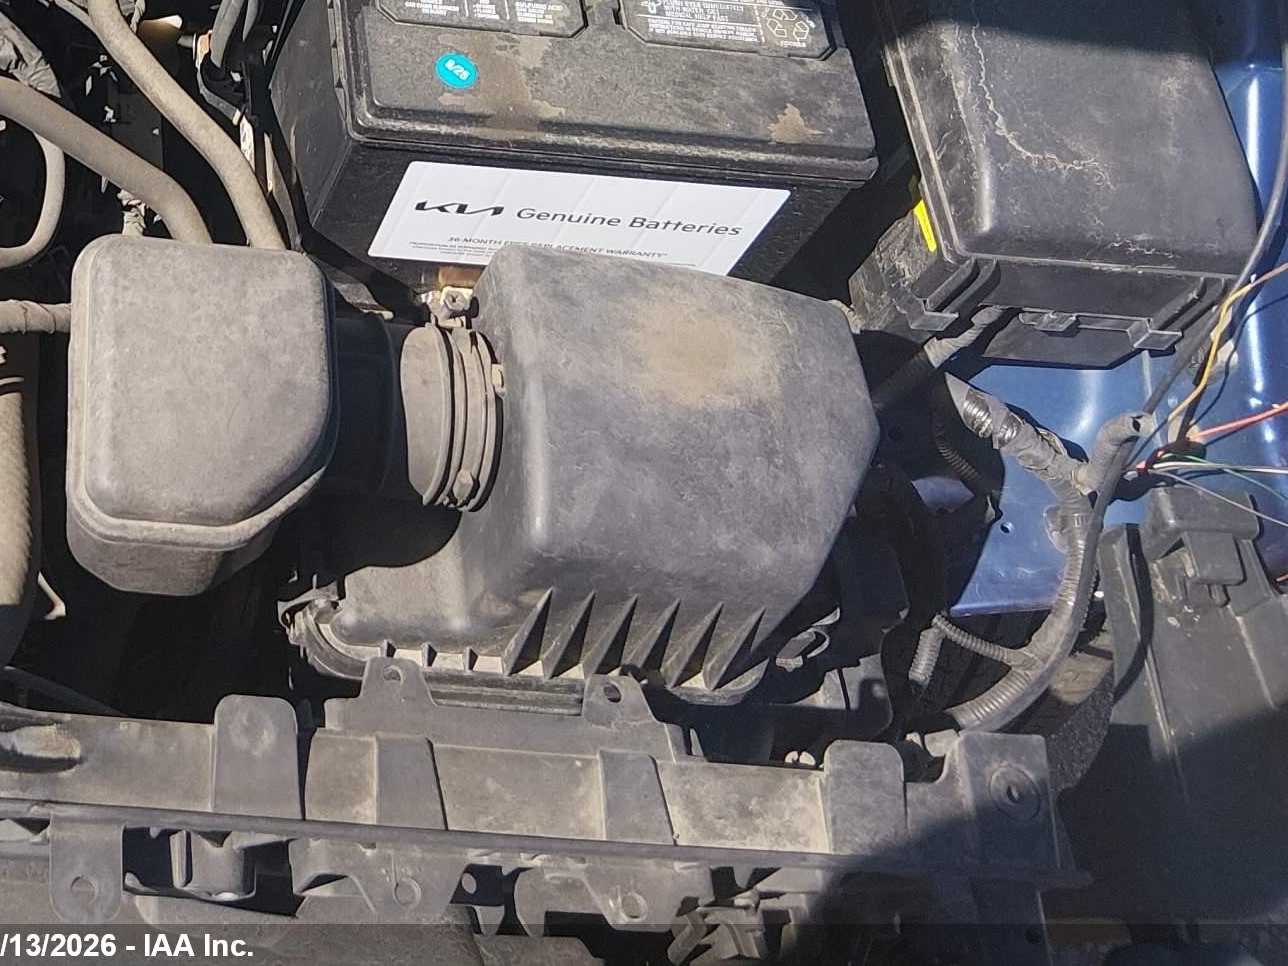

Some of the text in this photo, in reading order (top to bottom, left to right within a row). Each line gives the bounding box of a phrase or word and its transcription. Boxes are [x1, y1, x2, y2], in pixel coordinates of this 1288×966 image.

[414, 200, 743, 238] KIA Genuine Batteries
